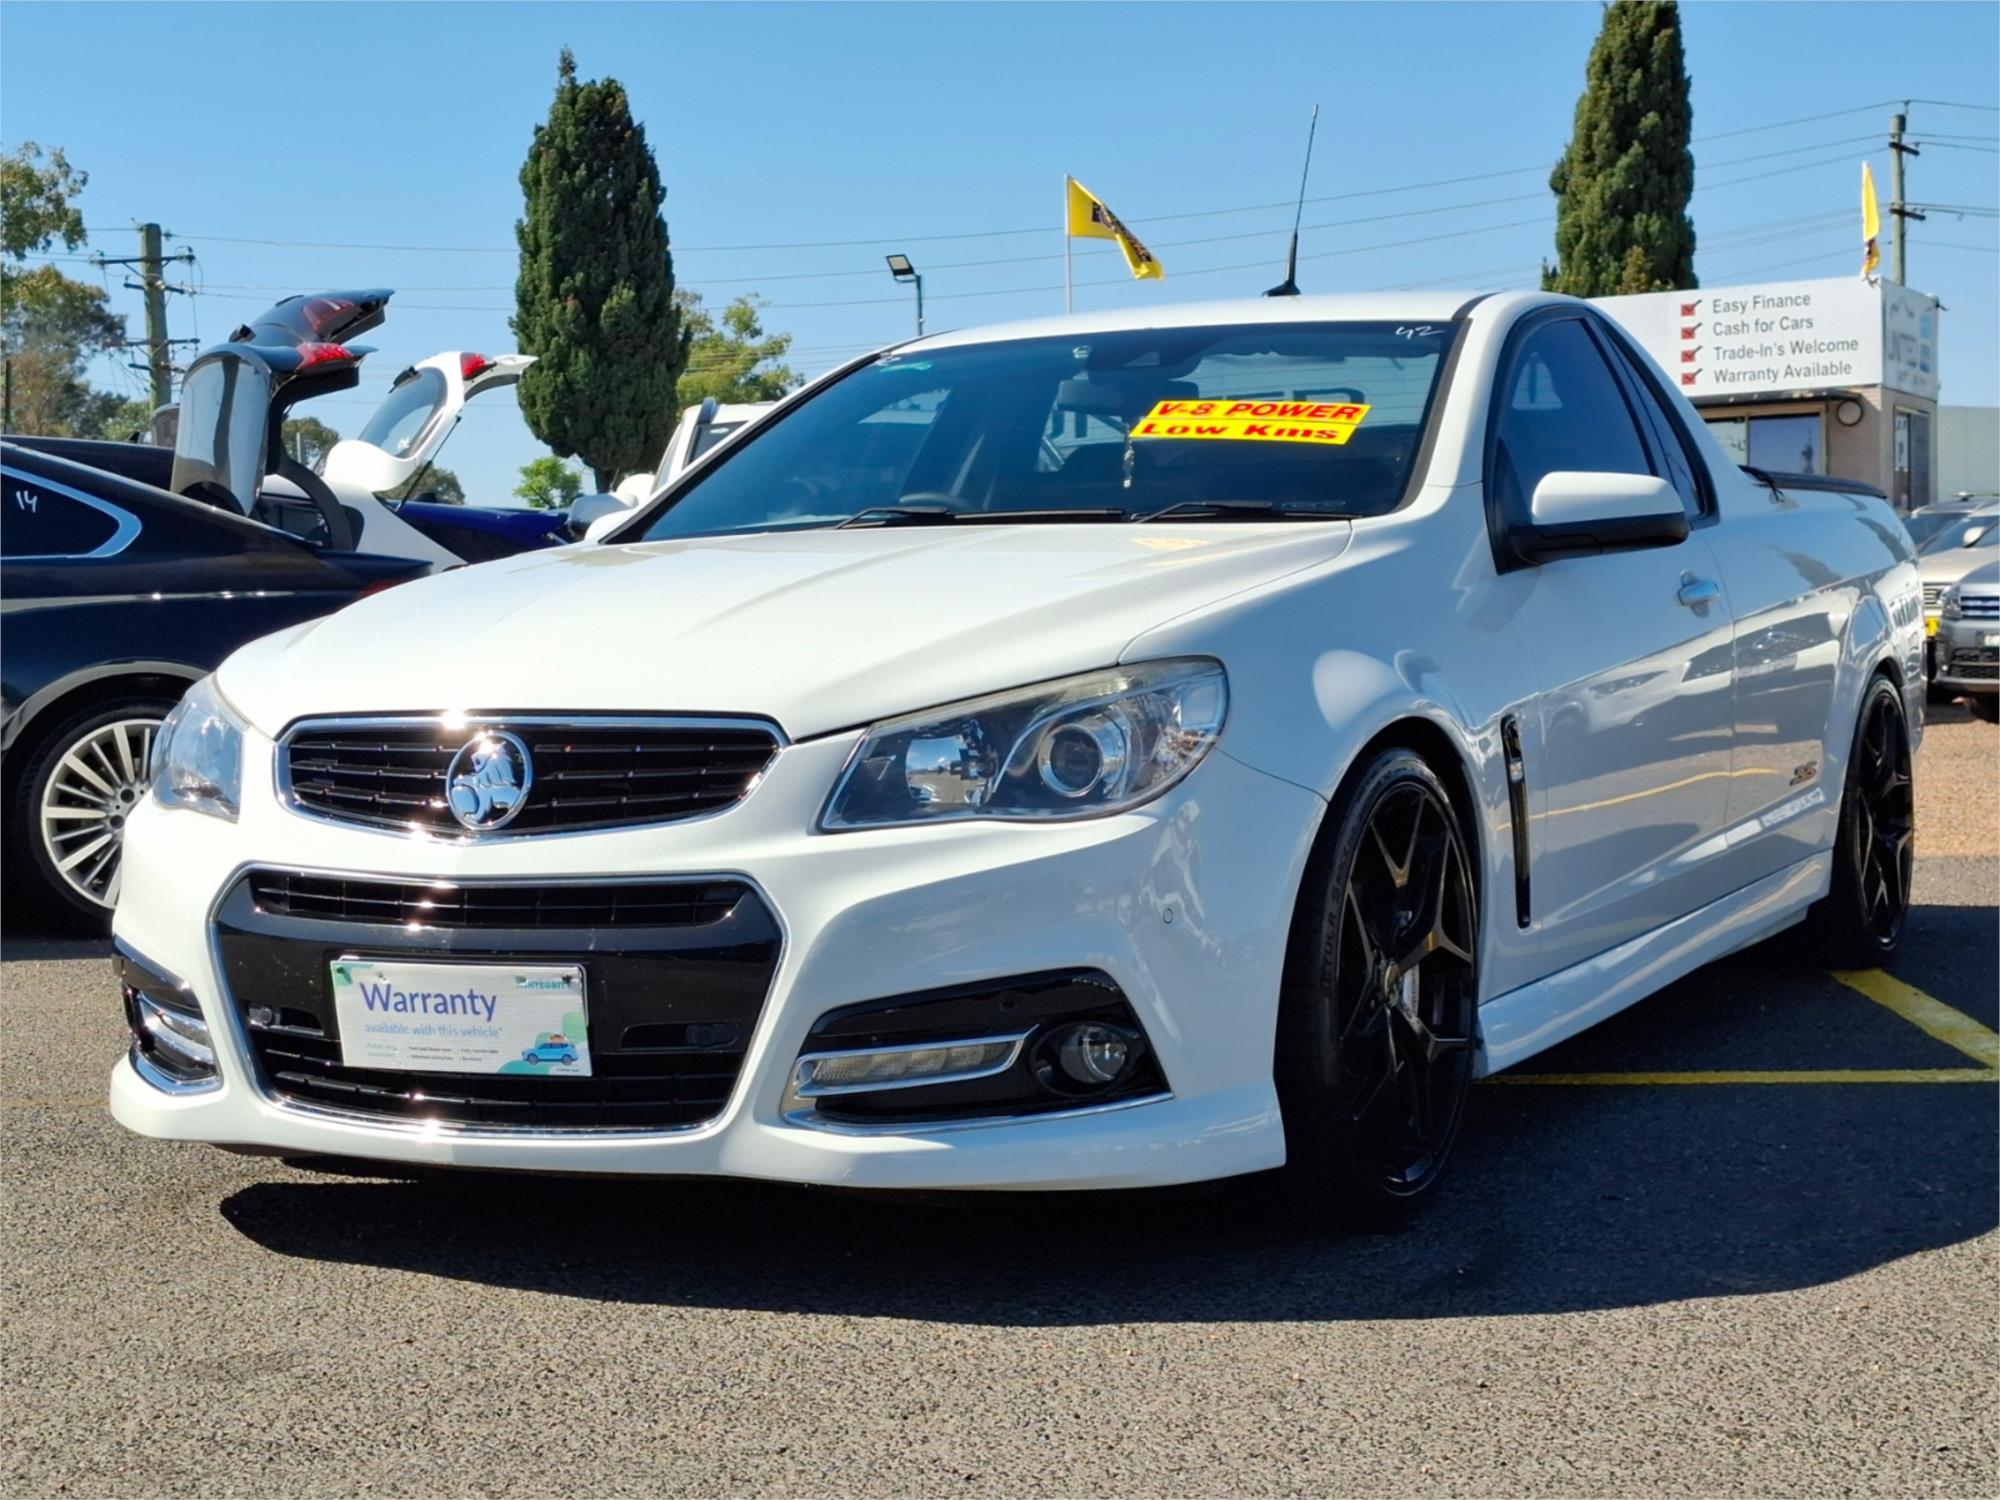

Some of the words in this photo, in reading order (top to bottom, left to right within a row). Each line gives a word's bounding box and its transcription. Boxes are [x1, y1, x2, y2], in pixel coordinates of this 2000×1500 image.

[1712, 298, 1748, 317] Easy
[1753, 294, 1811, 311] Finance
[1395, 325, 1446, 340] 42
[1713, 317, 1750, 337] Cash
[1754, 318, 1774, 334] for
[1779, 316, 1814, 332] Cars
[1714, 340, 1786, 362] Trade-In's
[1790, 337, 1859, 355] Welcome
[1714, 365, 1779, 386] Warranty
[1783, 360, 1852, 379] Available
[1157, 402, 1219, 416] V-8
[1223, 402, 1362, 420] POWER
[1140, 422, 1229, 436] Low
[1242, 424, 1340, 440] Kms
[15, 490, 38, 513] 14
[359, 981, 497, 1022] Warranty
[364, 1022, 410, 1036] available
[413, 1022, 435, 1036] with
[438, 1023, 458, 1037] this
